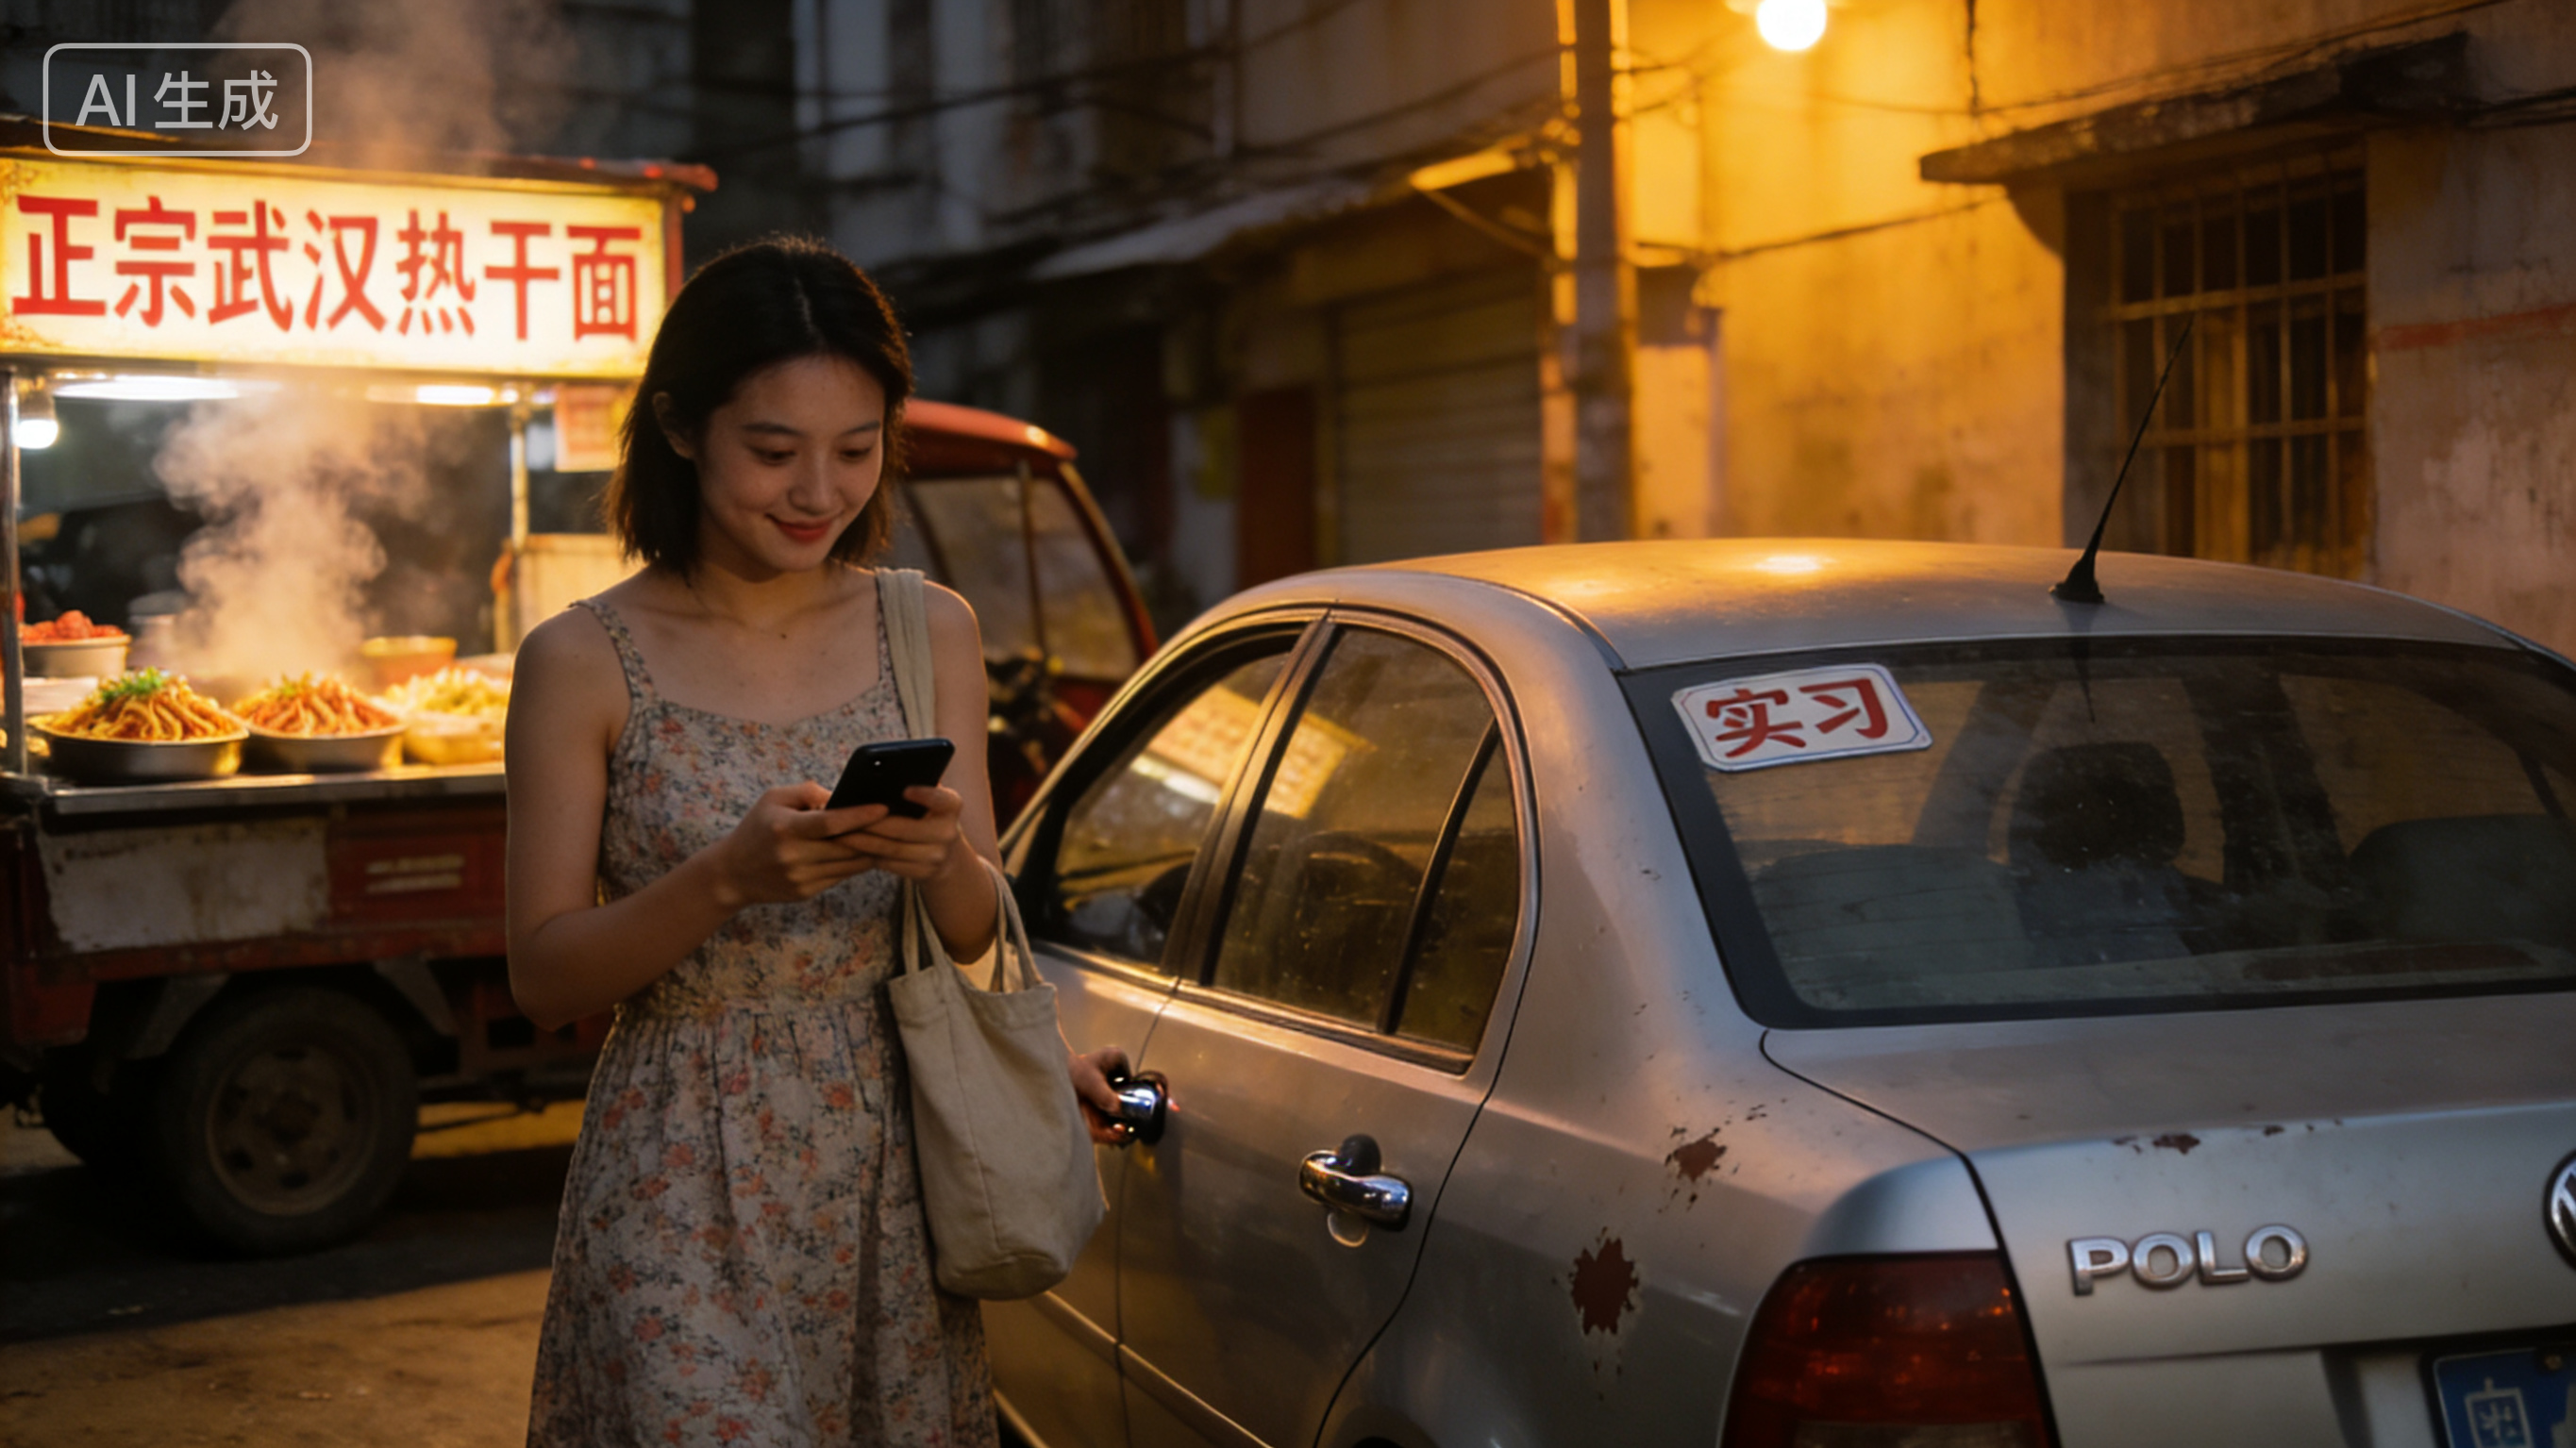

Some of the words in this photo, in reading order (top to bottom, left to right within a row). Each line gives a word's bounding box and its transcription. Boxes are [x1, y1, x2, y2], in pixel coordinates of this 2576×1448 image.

[11, 193, 643, 342] 正宗武汉热干面
[1705, 677, 1889, 758] 实习
[2068, 1225, 2308, 1296] POLO
